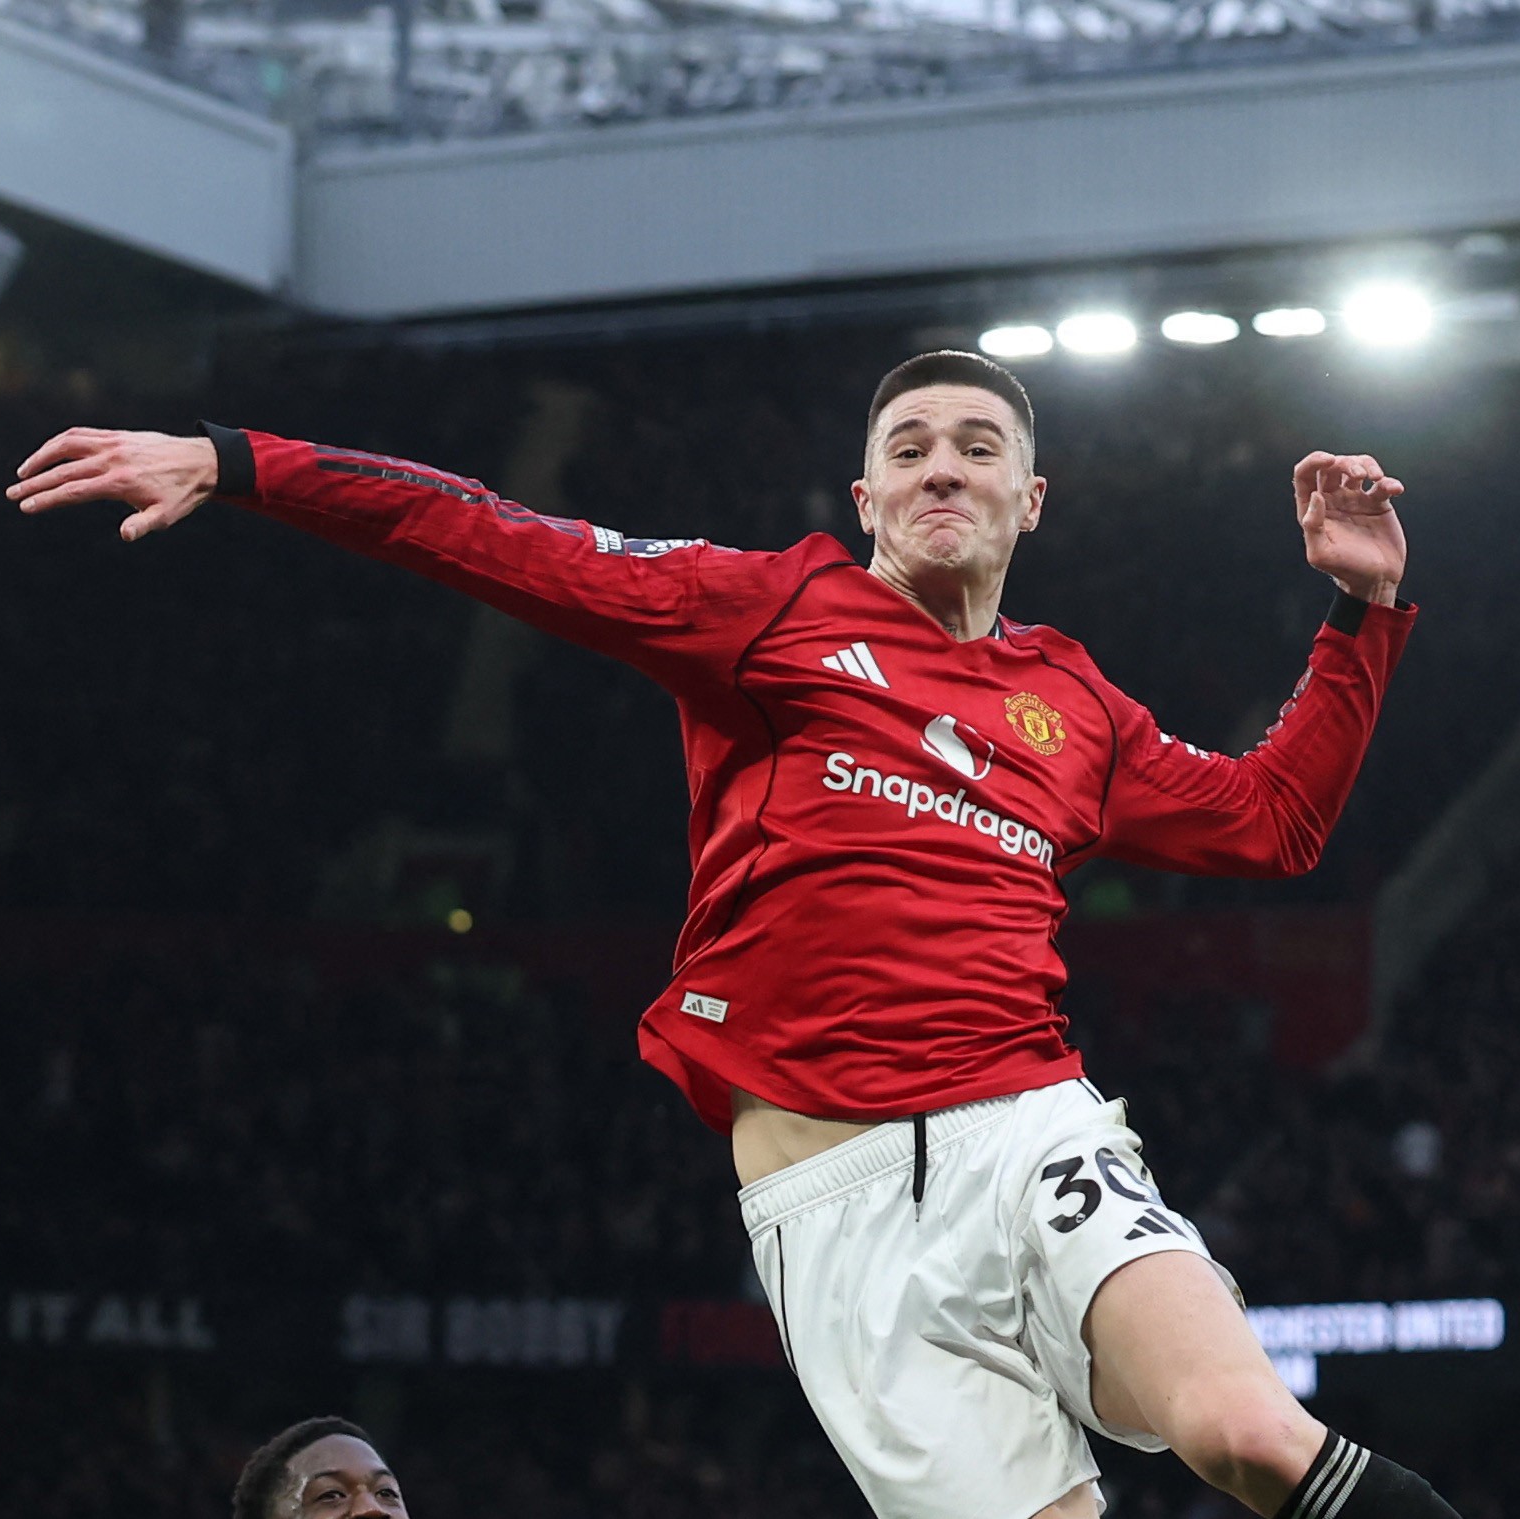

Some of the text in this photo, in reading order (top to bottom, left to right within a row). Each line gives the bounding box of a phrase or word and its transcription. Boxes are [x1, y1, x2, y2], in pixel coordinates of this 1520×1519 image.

[822, 752, 1054, 872] Snapdragon
[1040, 1148, 1165, 1233] 30
[9, 1292, 74, 1343] IT
[87, 1293, 216, 1349] ALL
